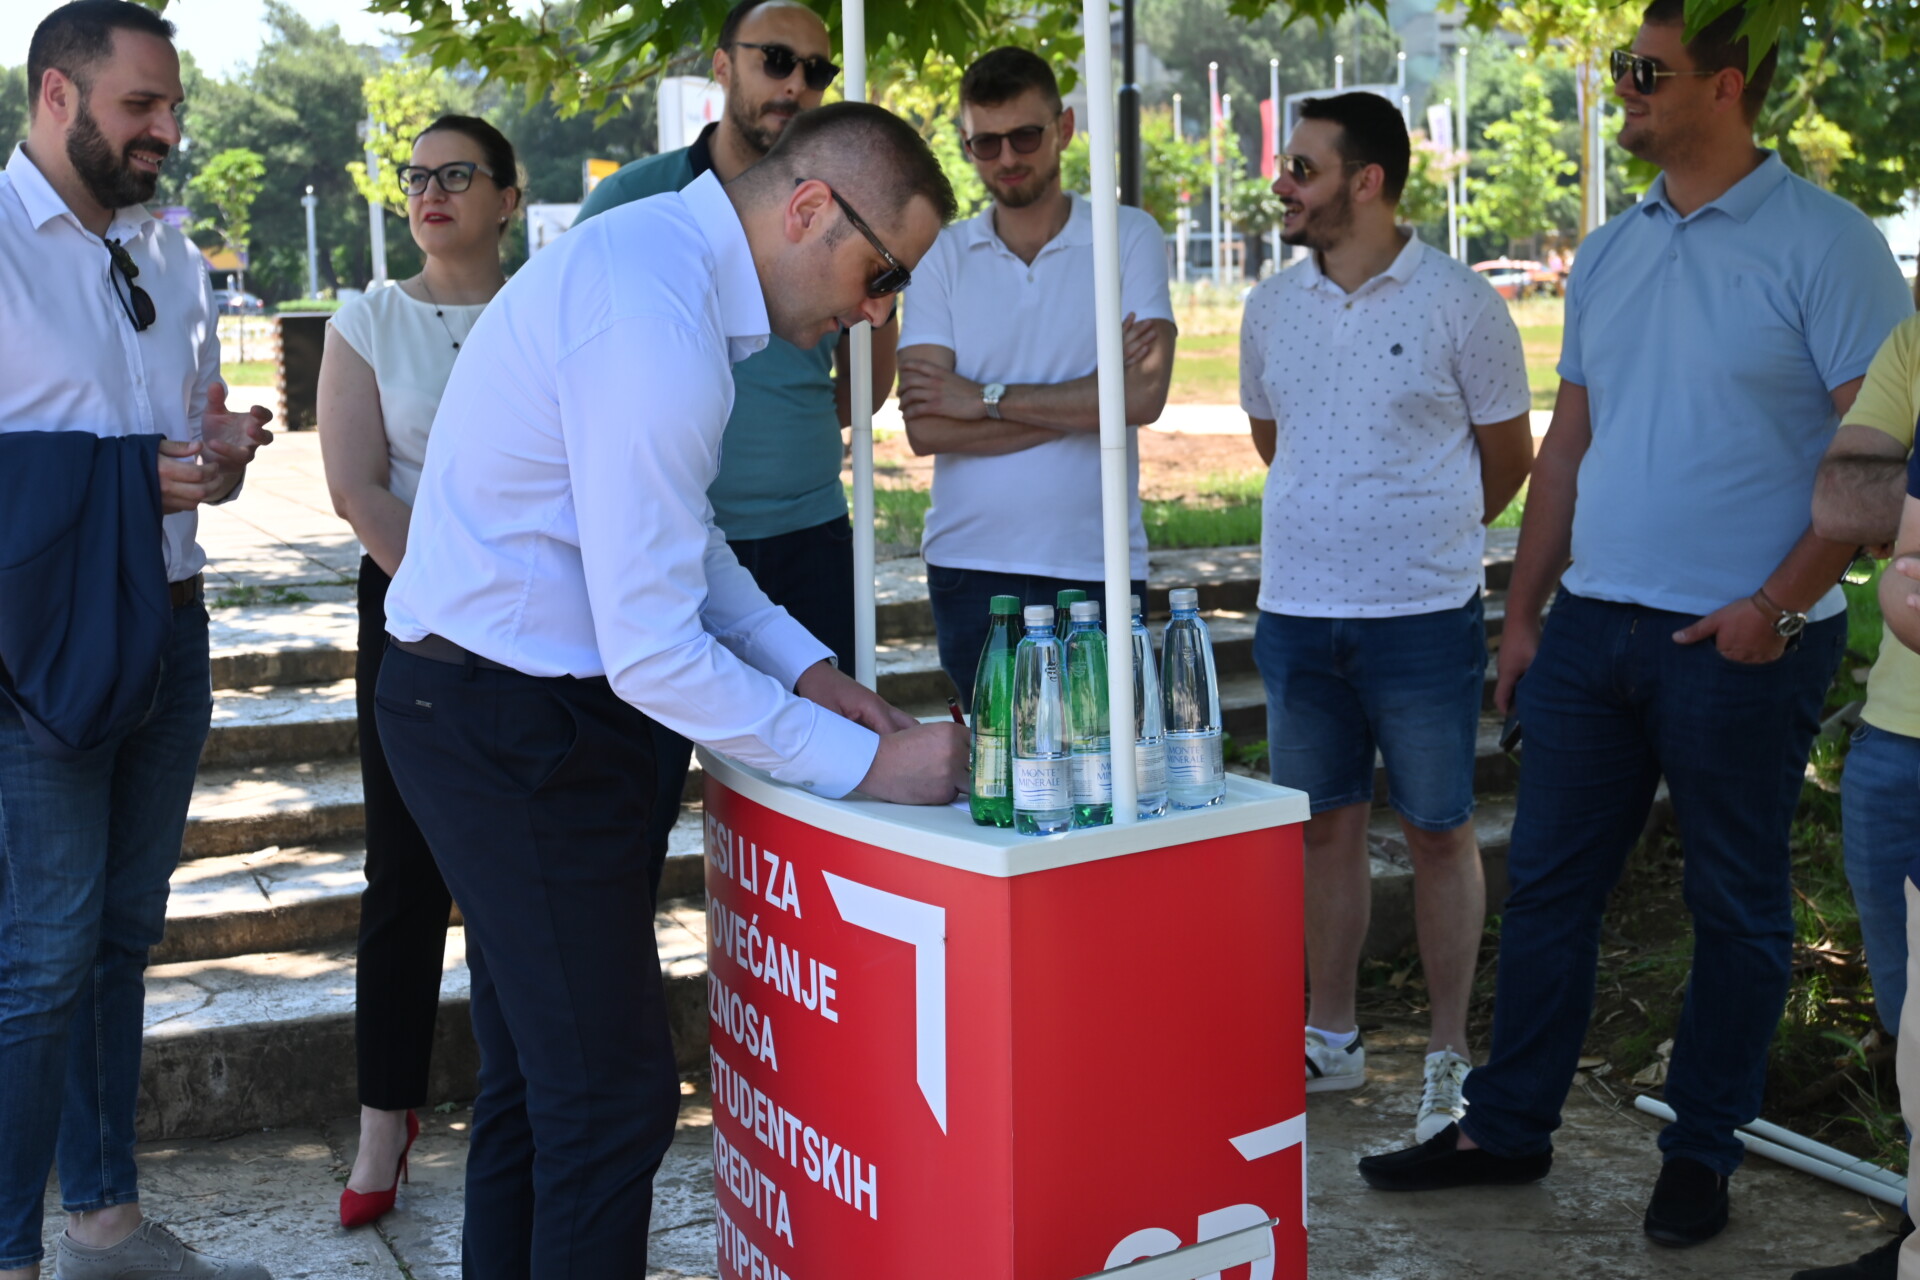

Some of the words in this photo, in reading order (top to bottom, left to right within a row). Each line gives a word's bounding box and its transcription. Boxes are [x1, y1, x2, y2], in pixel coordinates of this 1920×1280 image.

[1019, 778, 1060, 786] MINERALE
[1021, 768, 1056, 777] MONTE
[738, 835, 758, 895] LI
[763, 849, 802, 919] ZA
[709, 1044, 878, 1221] STUDENTSKIH
[713, 1120, 794, 1248] KREDITA
[715, 1197, 791, 1280] STIPE
